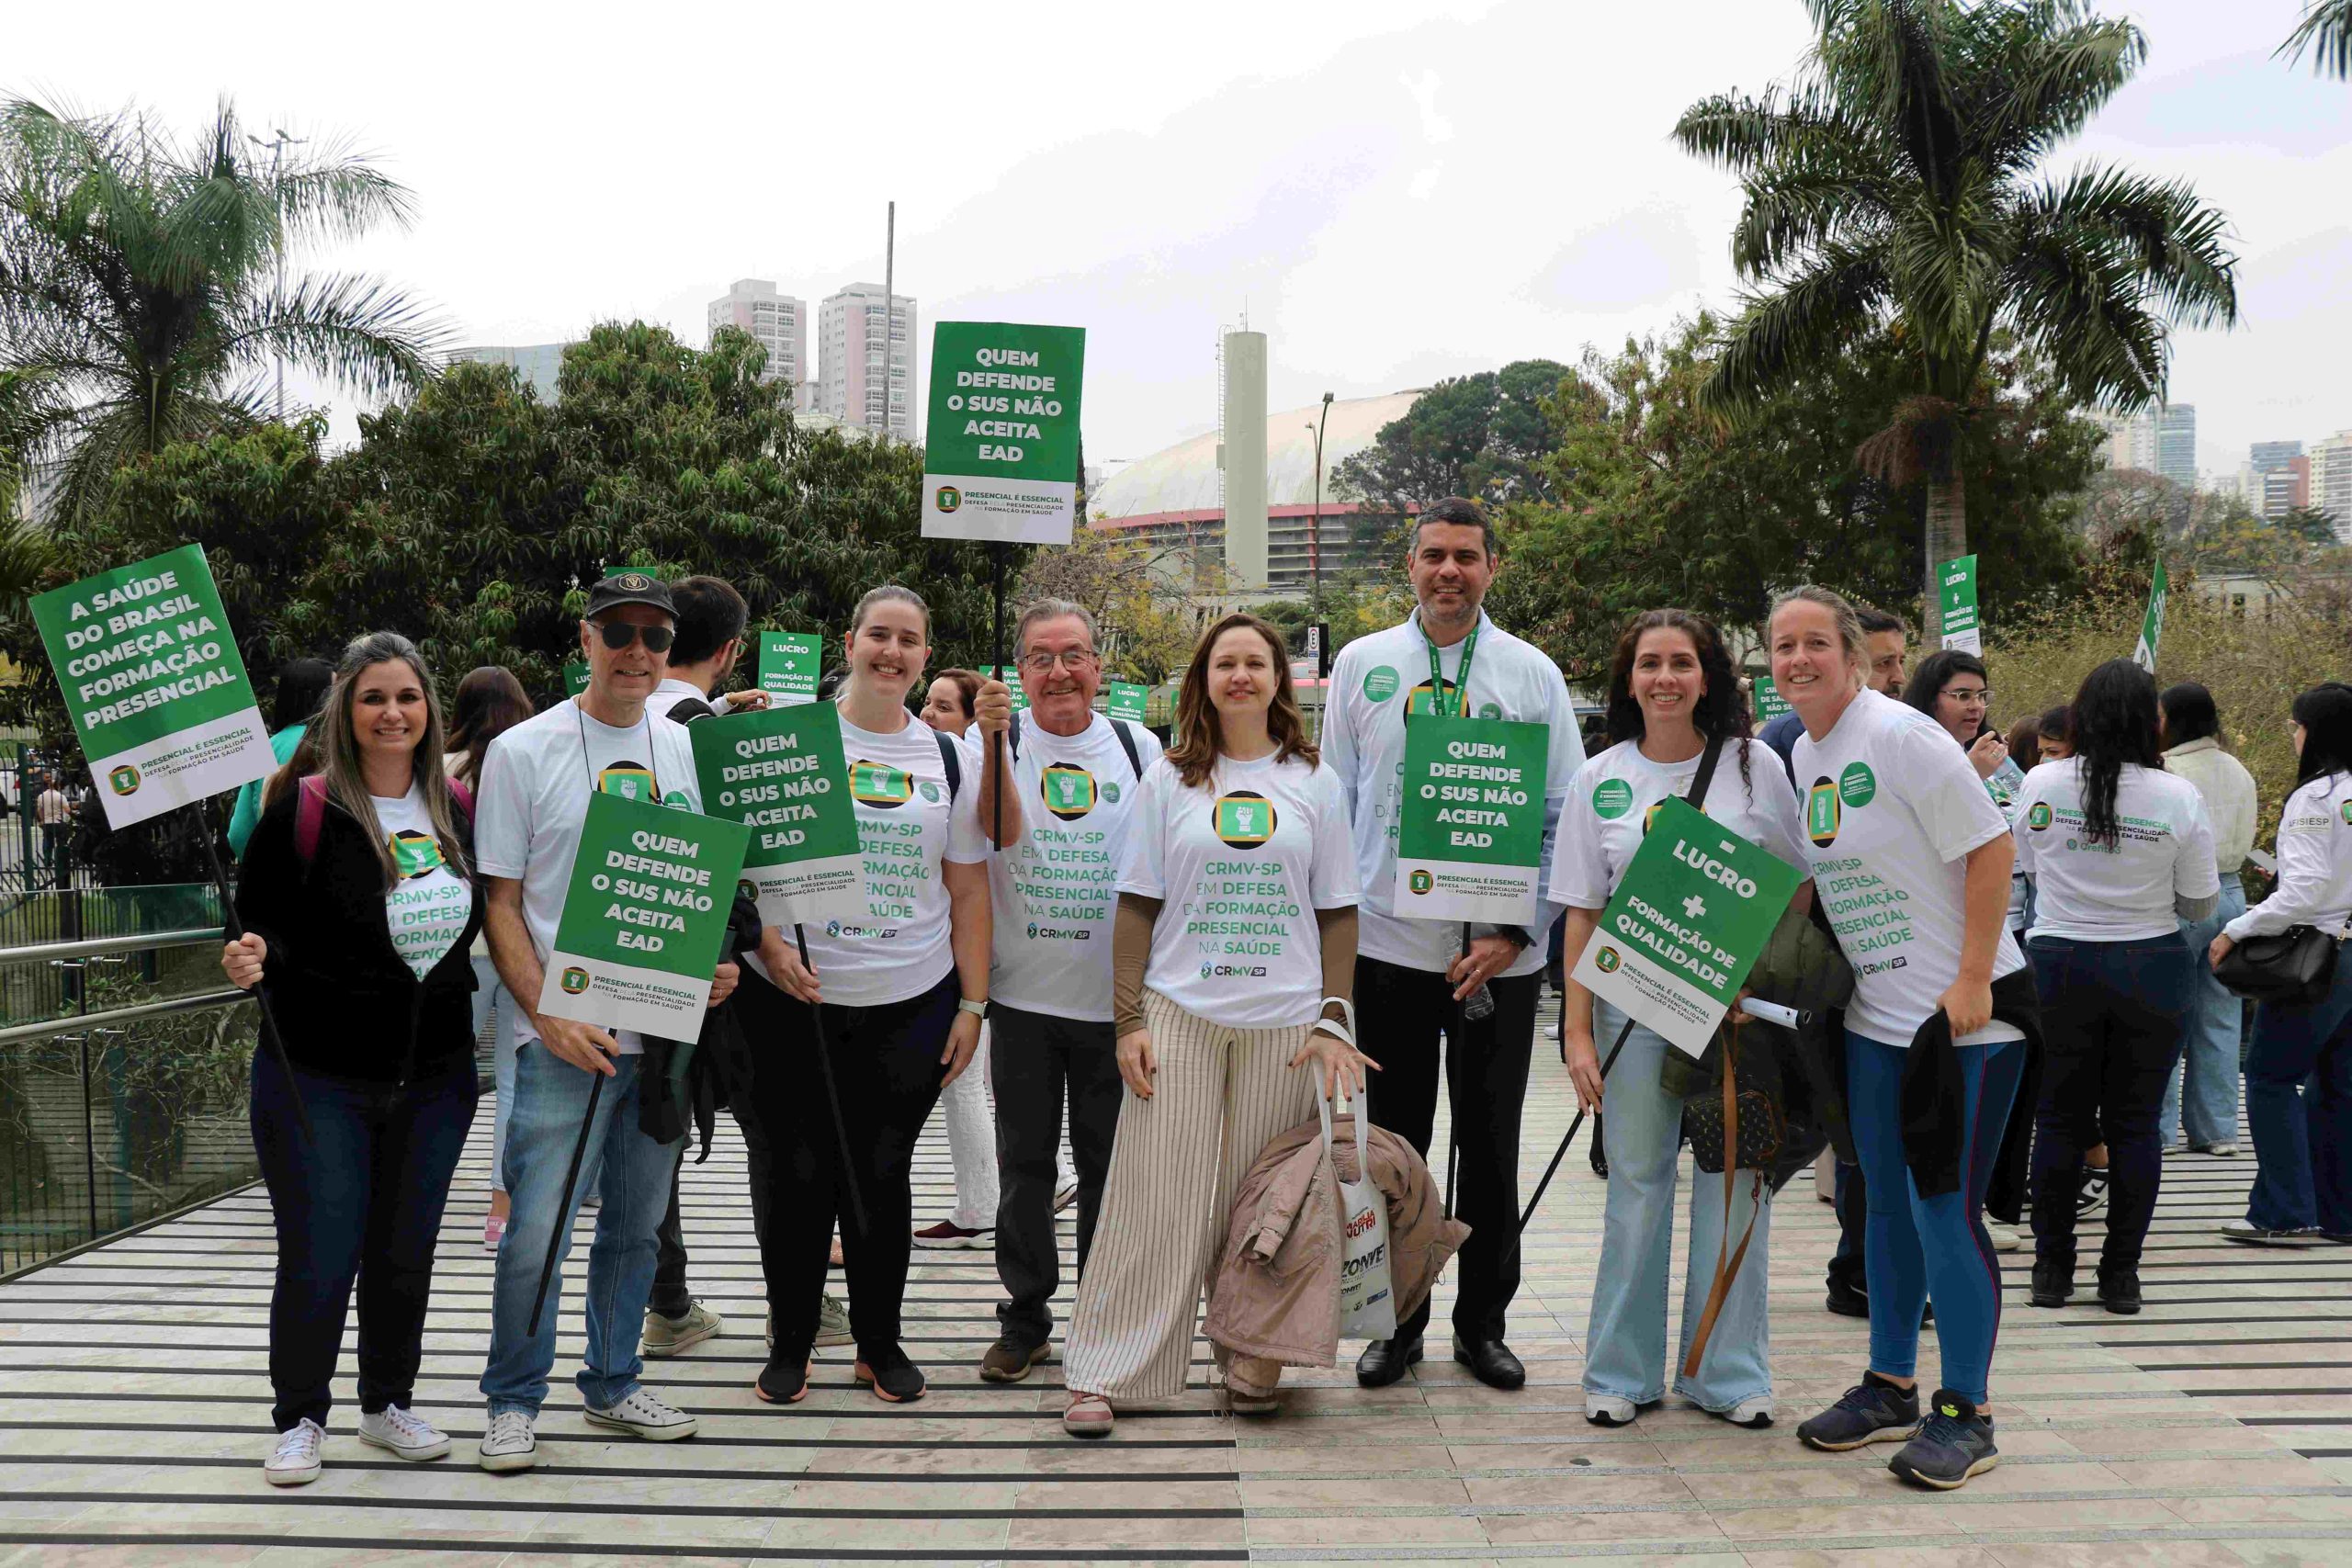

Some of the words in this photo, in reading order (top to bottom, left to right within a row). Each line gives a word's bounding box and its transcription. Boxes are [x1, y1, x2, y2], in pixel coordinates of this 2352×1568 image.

[976, 348, 1039, 367] QUEM
[957, 372, 1055, 391] DEFENDE
[947, 395, 964, 411] O
[968, 396, 1009, 412] SUS
[1014, 396, 1062, 416] NÃO
[964, 420, 1041, 439] ACEITA
[979, 445, 1023, 462] EAD
[966, 491, 1012, 500] PRESENCIAL
[1022, 495, 1064, 503] ESSENCIAL
[985, 506, 1020, 514] FORMAÇÃO
[1945, 572, 1967, 586] LUCRO
[71, 602, 90, 621] A
[93, 570, 179, 612] SAÚDE
[65, 625, 103, 650] DO
[108, 594, 200, 635] BRASIL
[68, 630, 175, 677] COMEÇA
[177, 616, 218, 641] NA
[773, 644, 809, 654] LUCRO
[1312, 634, 1316, 645] E
[79, 642, 220, 703] FORMAÇÃO
[764, 672, 803, 681] FORMAÇÃO
[763, 682, 814, 691] QUALIDADE
[84, 666, 237, 730] PRESENCIAL
[141, 747, 194, 770] PRESENCIAL
[196, 742, 202, 750] É
[203, 728, 251, 748] ESSENCIAL
[144, 764, 171, 777] DEFESA
[189, 735, 254, 761] PRESENCIALIDADE
[736, 734, 797, 759] QUEM
[1448, 741, 1506, 760] QUEM
[168, 758, 208, 775] FORMAÇÃO
[209, 754, 220, 762] EM
[722, 755, 820, 783] DEFENDE
[1430, 762, 1521, 783] DEFENDE
[719, 792, 735, 807] O
[740, 784, 780, 805] SUS
[784, 775, 831, 798] NÃO
[1420, 784, 1436, 799] O
[1441, 785, 1479, 802] SUS
[1484, 786, 1528, 806] NÃO
[743, 804, 818, 827] ACEITA
[1436, 808, 1509, 827] ACEITA
[2056, 807, 2087, 819] PRESE
[2123, 817, 2172, 830] ESSENCIAL
[856, 820, 922, 837] RMV-SP
[1033, 829, 1104, 844] CRMV-SP
[2055, 818, 2082, 826] DEFESA
[2119, 827, 2171, 836] SENCIALIDAD
[632, 830, 699, 859] QUEM
[761, 829, 806, 850] EAD
[1451, 831, 1493, 848] EAD
[2134, 834, 2159, 842] SAÚDE
[1022, 846, 1043, 860] EM
[1049, 849, 1110, 863] DEFESA
[606, 851, 712, 887] DEFENDE
[863, 861, 929, 881] RMAÇÃO
[1009, 863, 1027, 877] DA
[1032, 866, 1118, 885] FORMAÇÃO
[1205, 863, 1283, 875] CRMV-SP
[1672, 839, 1757, 898] LUCRO
[1812, 858, 1863, 876] CRMV-SP
[760, 876, 805, 886] PRESENCIAL
[814, 870, 854, 880] ESSENCIAL
[801, 878, 855, 888] PRESENCIALIDADE
[1438, 874, 1482, 884] PRESENCIAL
[1830, 874, 1884, 894] DEFESA
[592, 874, 610, 891] O
[614, 878, 659, 902] SUS
[662, 888, 713, 912] NÃO
[781, 888, 815, 897] FORMAÇÃO
[1015, 883, 1112, 900] PRESENCIAL
[1196, 883, 1216, 895] EM
[1223, 883, 1287, 897] DEFESA
[870, 901, 913, 919] AÚDE
[1024, 904, 1045, 917] NA
[1049, 905, 1105, 919] SAÚDE
[1183, 904, 1201, 916] DA
[1205, 901, 1300, 919] FORMAÇÃO
[1830, 888, 1909, 916] FORMAÇÃO
[402, 905, 470, 926] DEFESA
[605, 904, 685, 932] ACEITA
[842, 926, 882, 938] CRMV
[1040, 929, 1076, 940] CRMV
[1187, 922, 1289, 936] PRESENCIAL
[1627, 895, 1712, 953] FORMAÇÃO
[1713, 948, 1737, 970] DE
[616, 931, 664, 953] EAD
[1199, 942, 1220, 953] NA
[1224, 939, 1281, 955] SAÚDE
[1858, 928, 1915, 953] SAÚDE
[1616, 914, 1728, 990] QUALIDADE
[1215, 966, 1252, 976] CRMV
[1863, 960, 1891, 975] CRMV
[1894, 958, 1905, 966] SP
[593, 984, 618, 993] DEFESA
[636, 992, 695, 1008] PRESENCIALIDADE
[594, 976, 644, 990] PRESENCIAL
[646, 983, 652, 991] É
[653, 985, 697, 1000] ESSENCIAL
[1621, 969, 1641, 985] DEFESA
[1657, 992, 1707, 1025] PRESENCIALIDADE
[1624, 963, 1666, 992] PRESENCIAL
[1667, 987, 1672, 996] É
[1673, 992, 1711, 1020] ESSENCIAL
[1635, 986, 1667, 1006] FORMAÇÃO
[613, 994, 649, 1004] FORMAÇÃO
